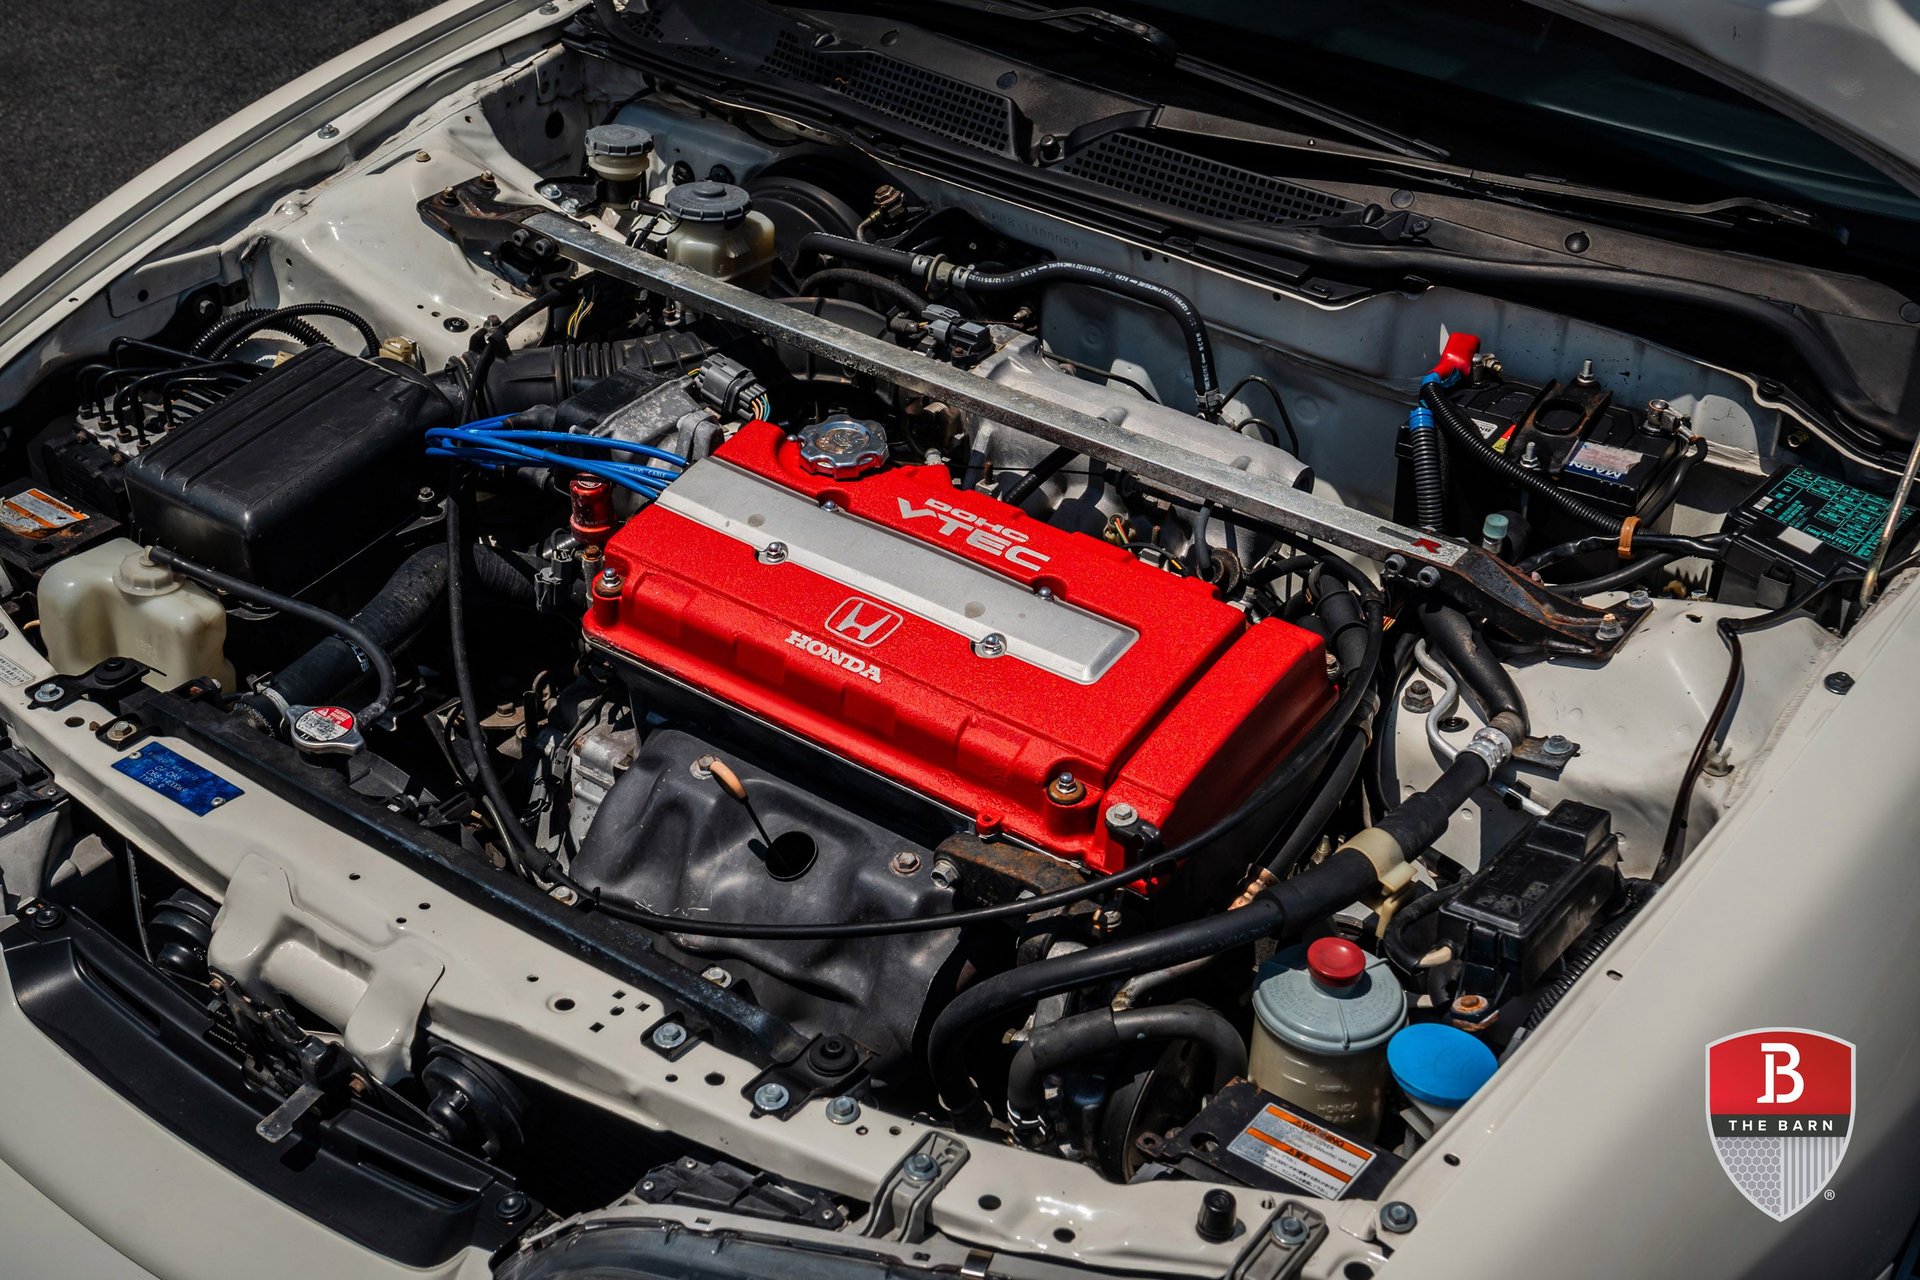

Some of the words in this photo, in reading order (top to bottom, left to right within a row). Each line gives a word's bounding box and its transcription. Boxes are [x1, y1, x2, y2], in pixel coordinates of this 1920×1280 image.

[897, 497, 1051, 572] VTEC
[924, 498, 1030, 543] DOHC
[784, 630, 882, 684] HONDA
